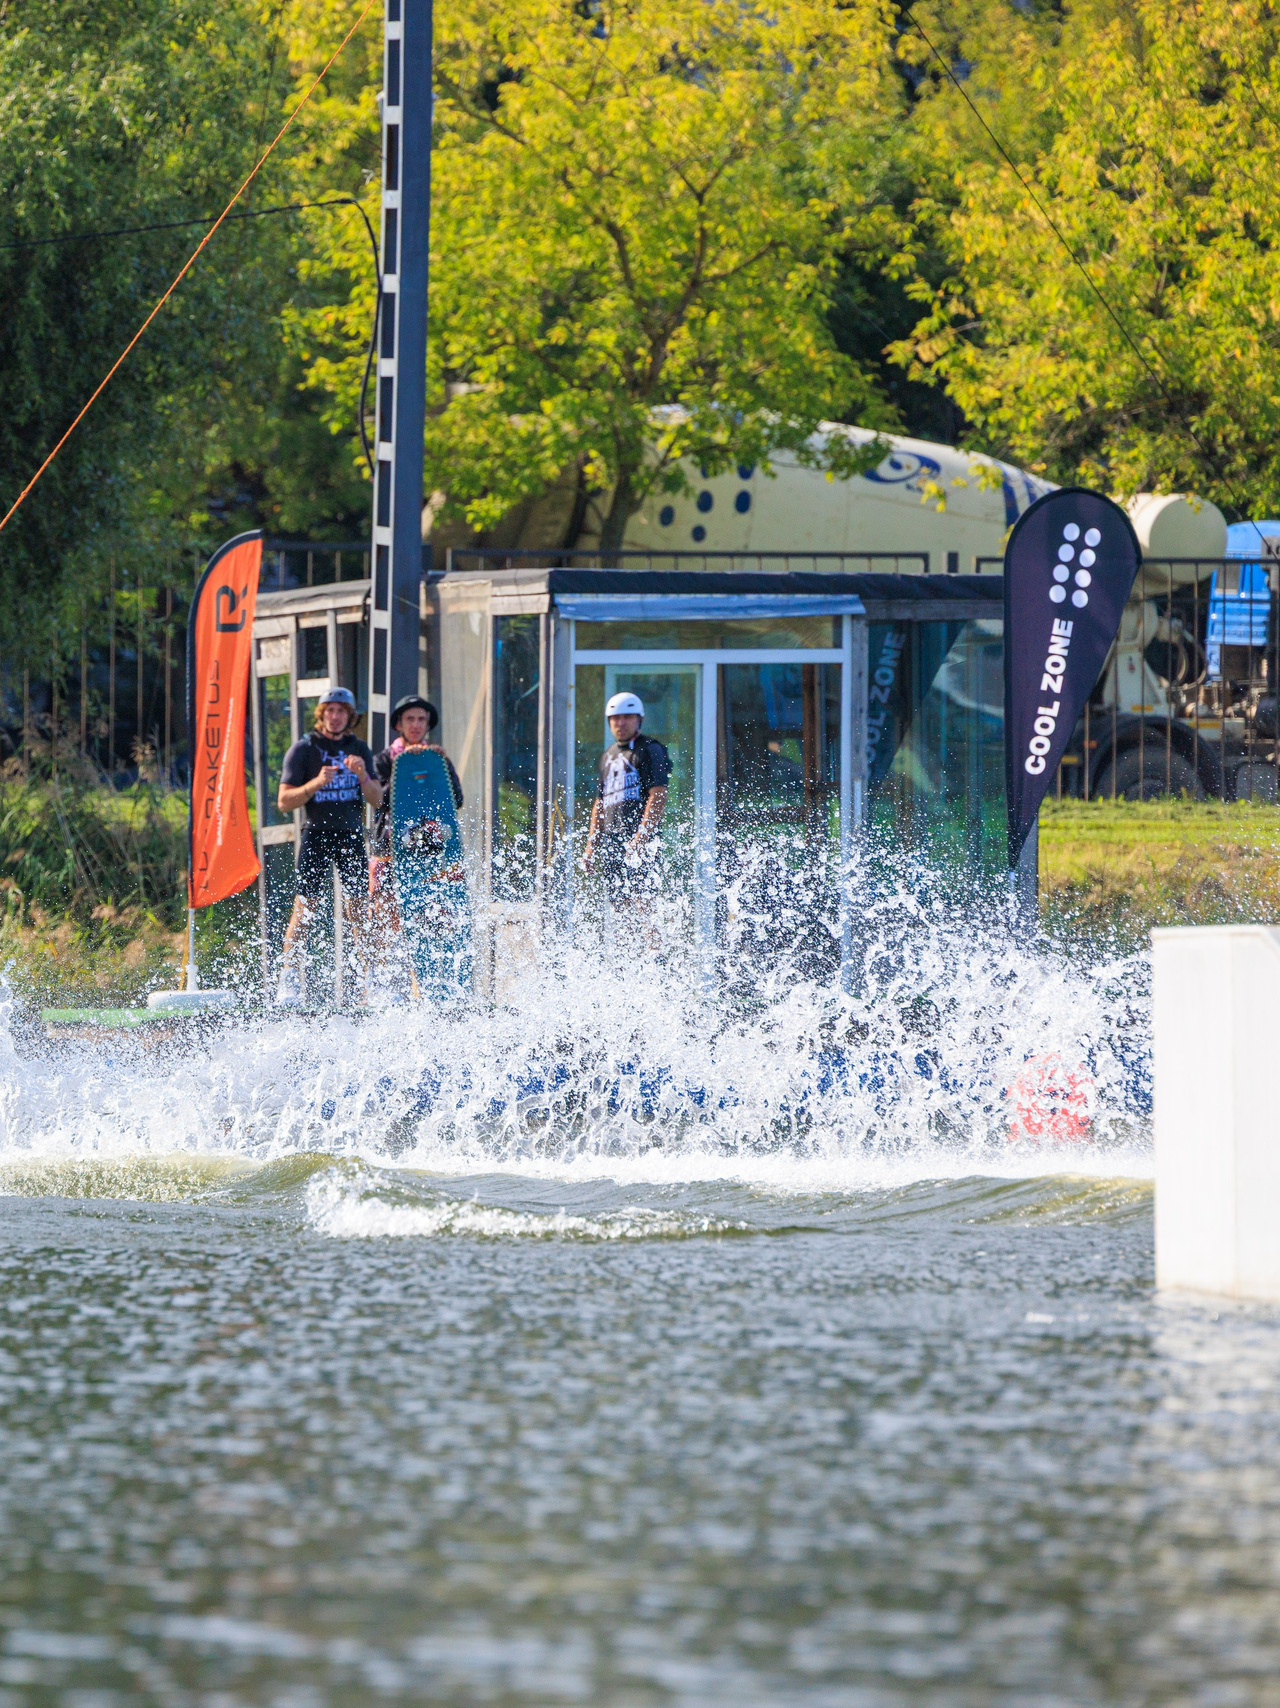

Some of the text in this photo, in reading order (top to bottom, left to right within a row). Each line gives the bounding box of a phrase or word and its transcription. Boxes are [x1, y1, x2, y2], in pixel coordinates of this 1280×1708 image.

[869, 632, 907, 704] ZONE
[1024, 617, 1074, 775] COOL ZONE
